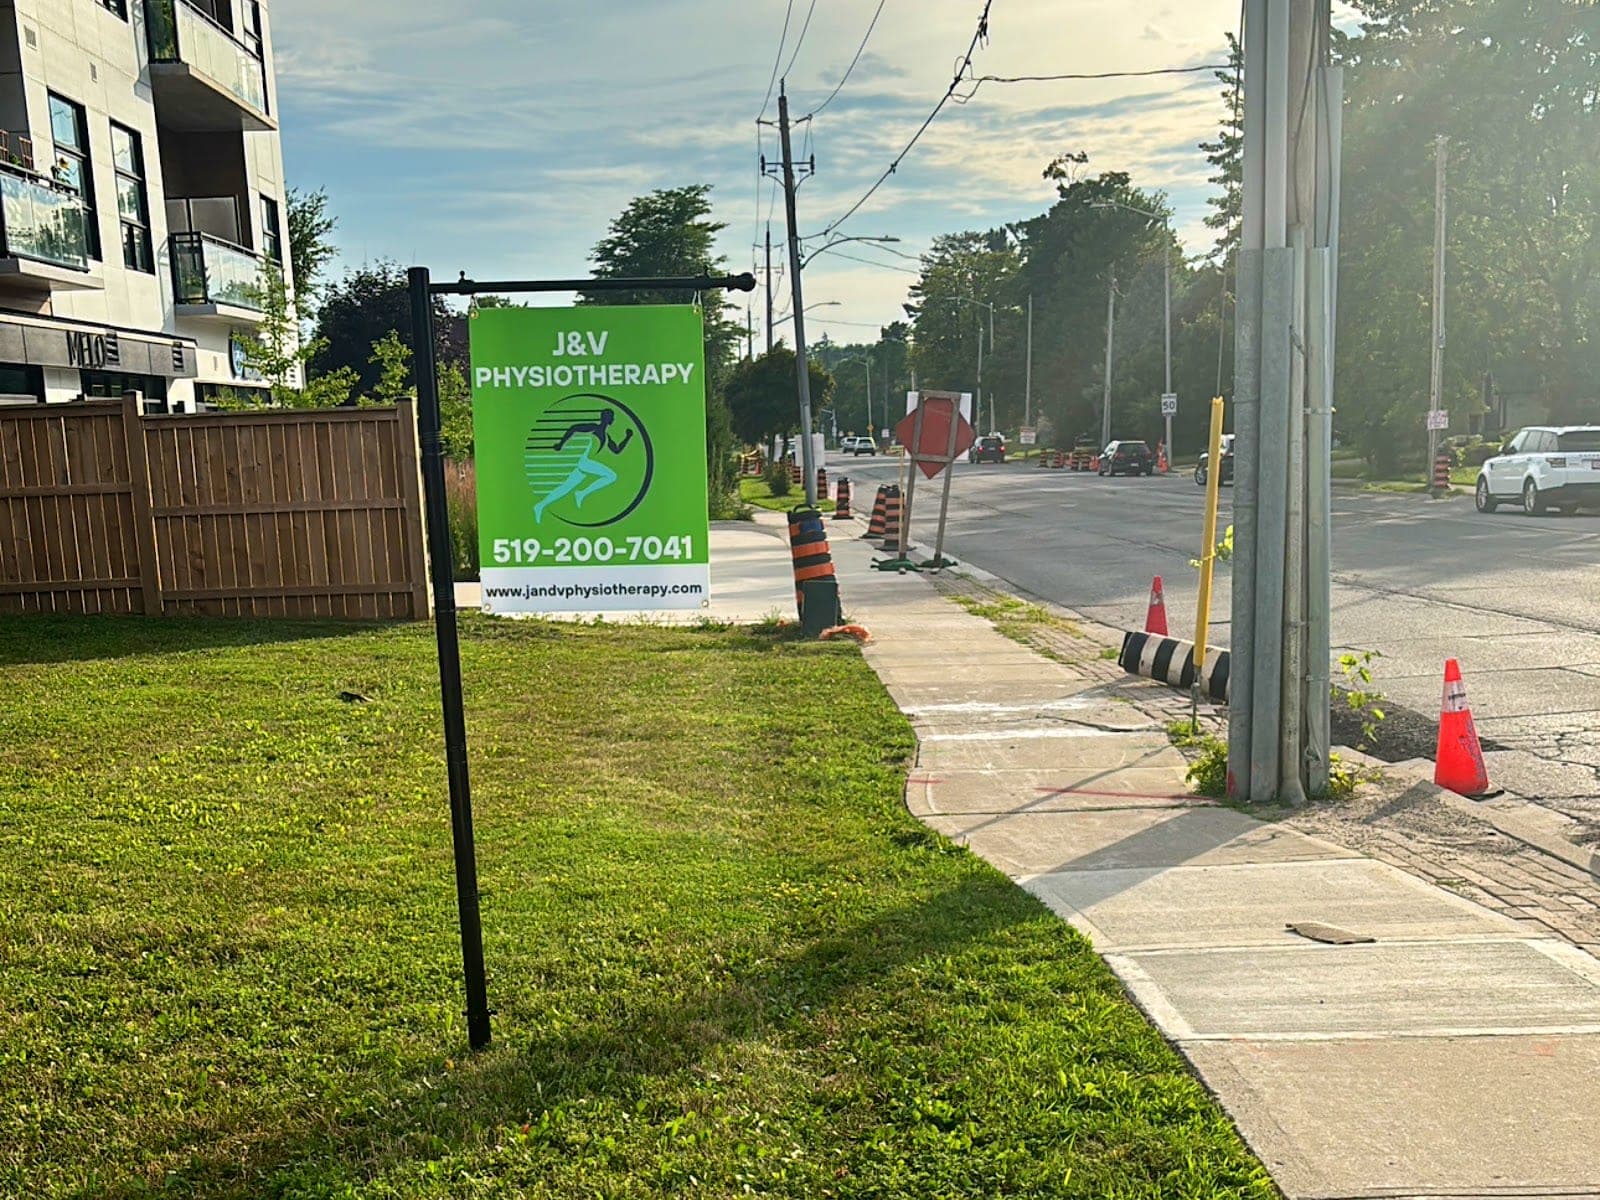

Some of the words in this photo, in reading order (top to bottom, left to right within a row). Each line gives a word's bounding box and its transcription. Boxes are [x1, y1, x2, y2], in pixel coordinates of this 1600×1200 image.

[553, 331, 608, 356] J&V
[475, 364, 694, 388] PHYSIOTHERAPY
[1163, 400, 1175, 410] 50
[493, 536, 692, 562] 519-200-7041
[485, 583, 702, 599] www.jandvphysiotherapy.com
